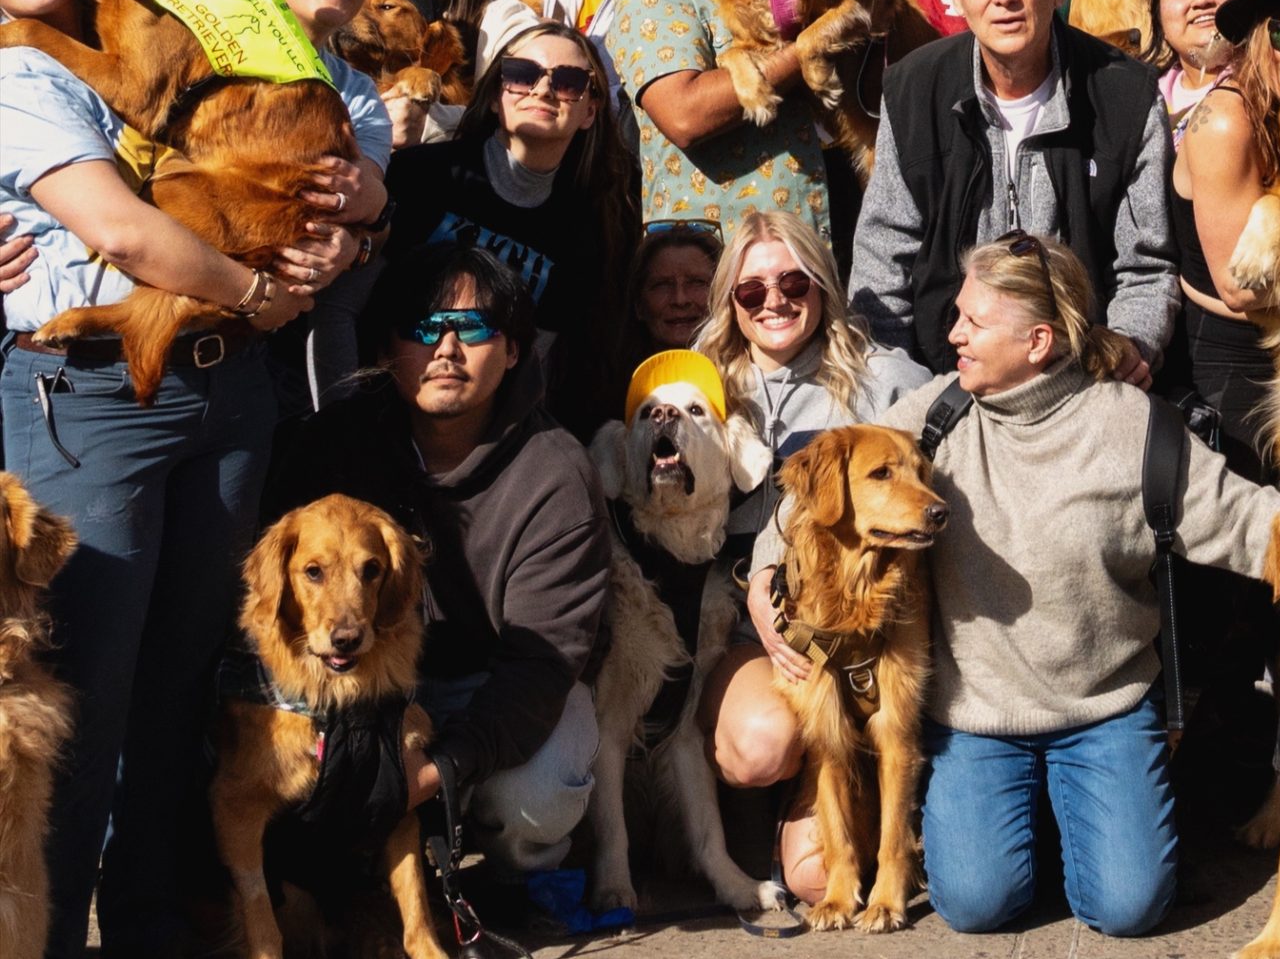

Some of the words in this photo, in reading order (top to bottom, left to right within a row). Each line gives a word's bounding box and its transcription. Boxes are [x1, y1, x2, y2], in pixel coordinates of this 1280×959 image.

[195, 3, 249, 66] GOLDEN
[268, 19, 288, 47] YOU
[287, 48, 306, 73] LLC
